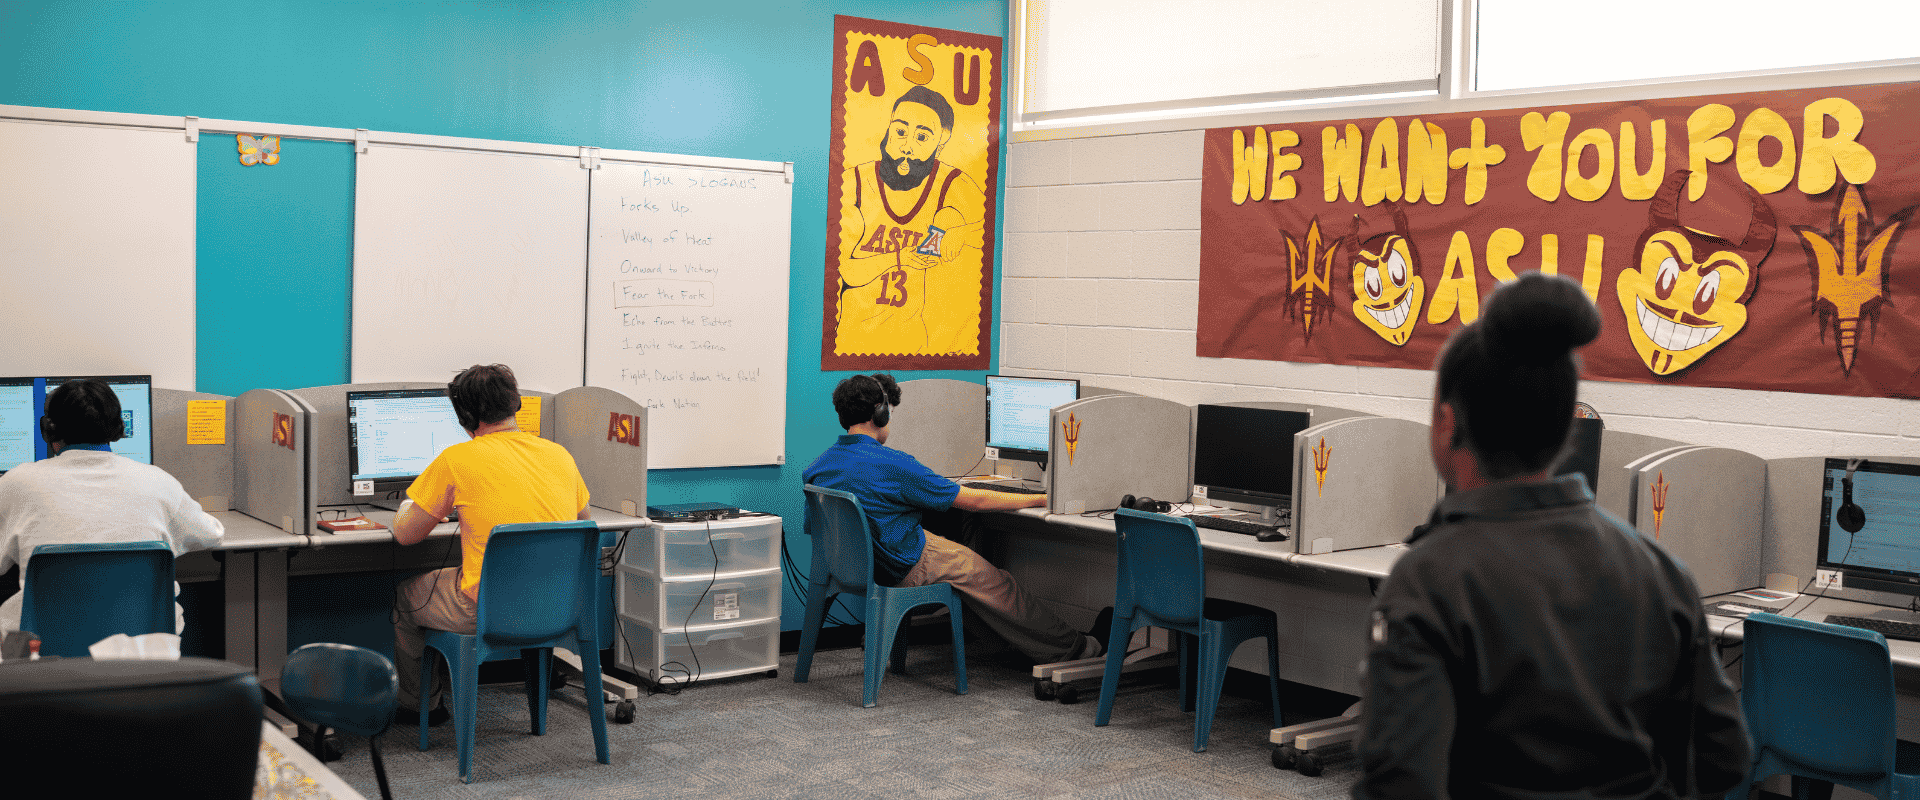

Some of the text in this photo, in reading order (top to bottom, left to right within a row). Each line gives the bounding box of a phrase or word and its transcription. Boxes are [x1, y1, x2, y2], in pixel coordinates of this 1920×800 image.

[849, 33, 981, 106] ASU
[1232, 126, 1302, 206] WE
[1520, 111, 1667, 202] YOU
[1686, 97, 1877, 202] FOR
[620, 196, 660, 213] Forks
[621, 229, 715, 250] Valley of Heat
[860, 224, 924, 253] ASU
[620, 259, 719, 278] Onward to Victory
[623, 286, 706, 300] Fear the Fork
[875, 270, 908, 308] 13
[623, 313, 645, 327] Echo
[653, 317, 675, 326] from
[681, 315, 695, 326] the
[623, 337, 726, 355] Ignite the Inferno
[654, 369, 683, 382] Devils
[690, 371, 711, 382] down
[716, 371, 731, 382] the
[673, 398, 700, 409] Nation
[607, 411, 641, 447] ASU
